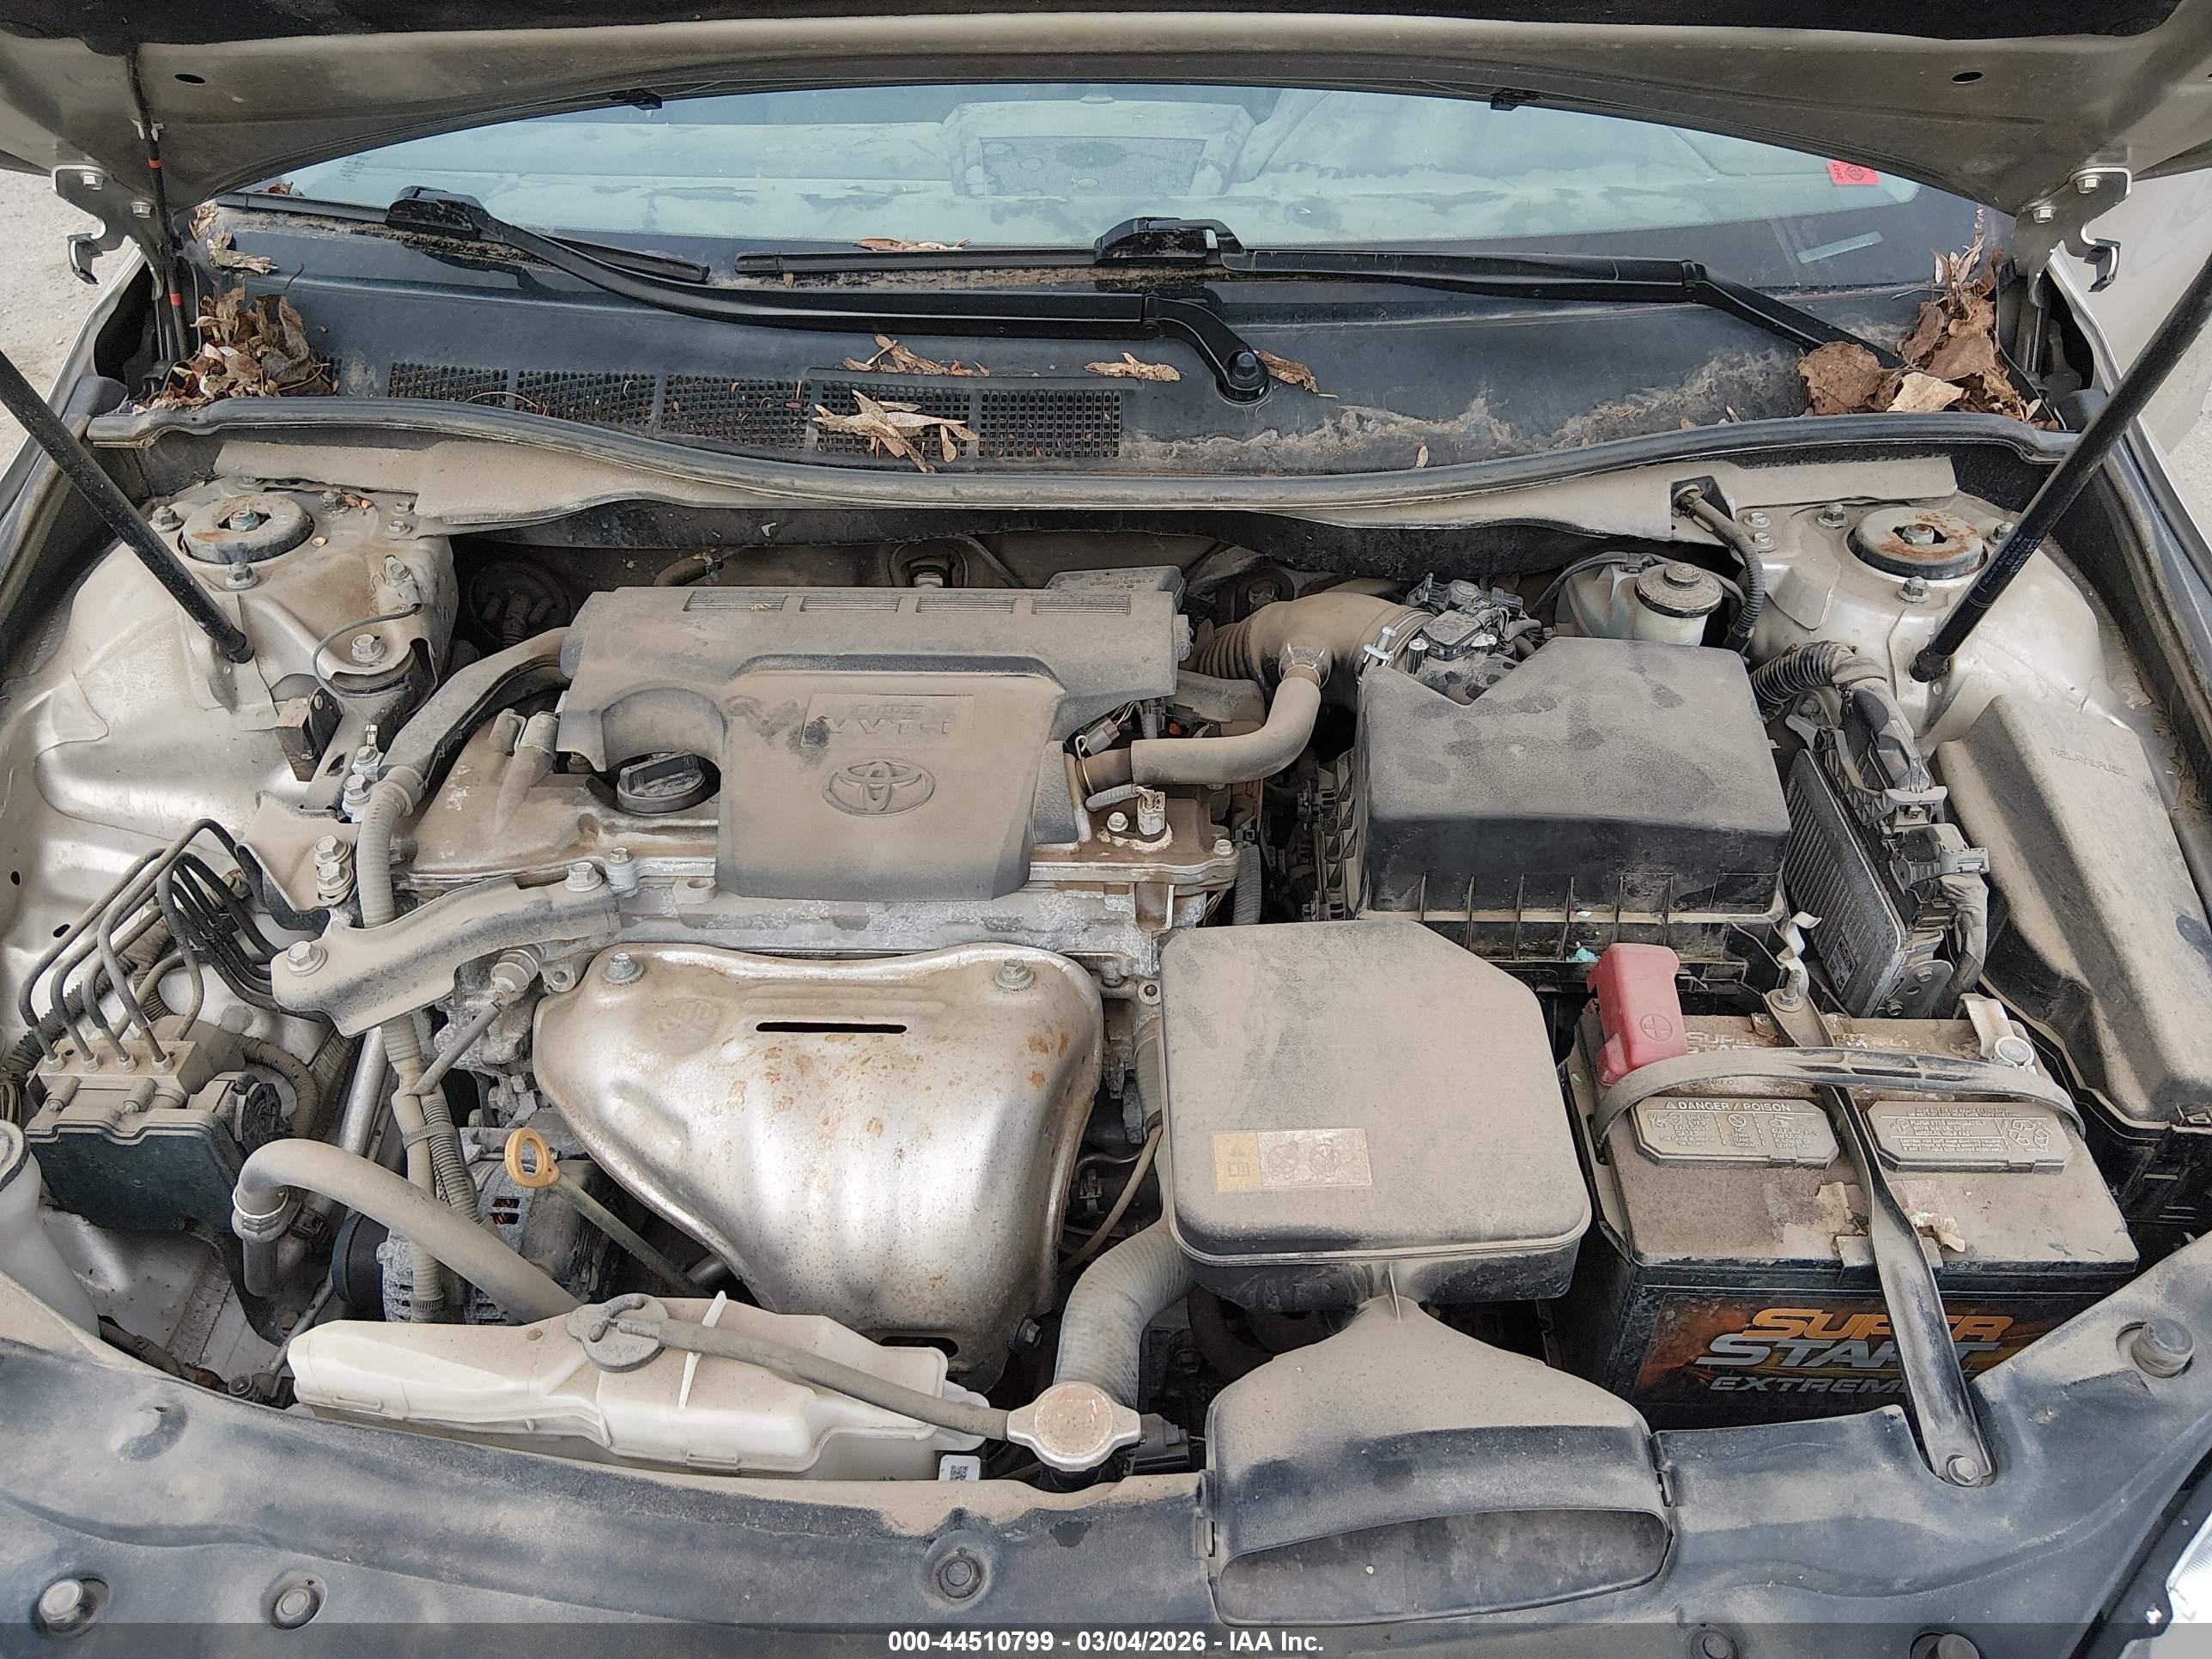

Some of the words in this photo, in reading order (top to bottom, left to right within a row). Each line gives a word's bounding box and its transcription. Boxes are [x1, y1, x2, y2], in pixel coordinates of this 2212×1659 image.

[1678, 1101, 1729, 1110] DANGER
[1733, 1103, 1739, 1111] /
[1743, 1103, 1791, 1112] POISON
[1741, 1308, 2013, 1341] SUPR
[594, 1344, 646, 1355] COOLANT
[1710, 1376, 1911, 1395] EXTREM
